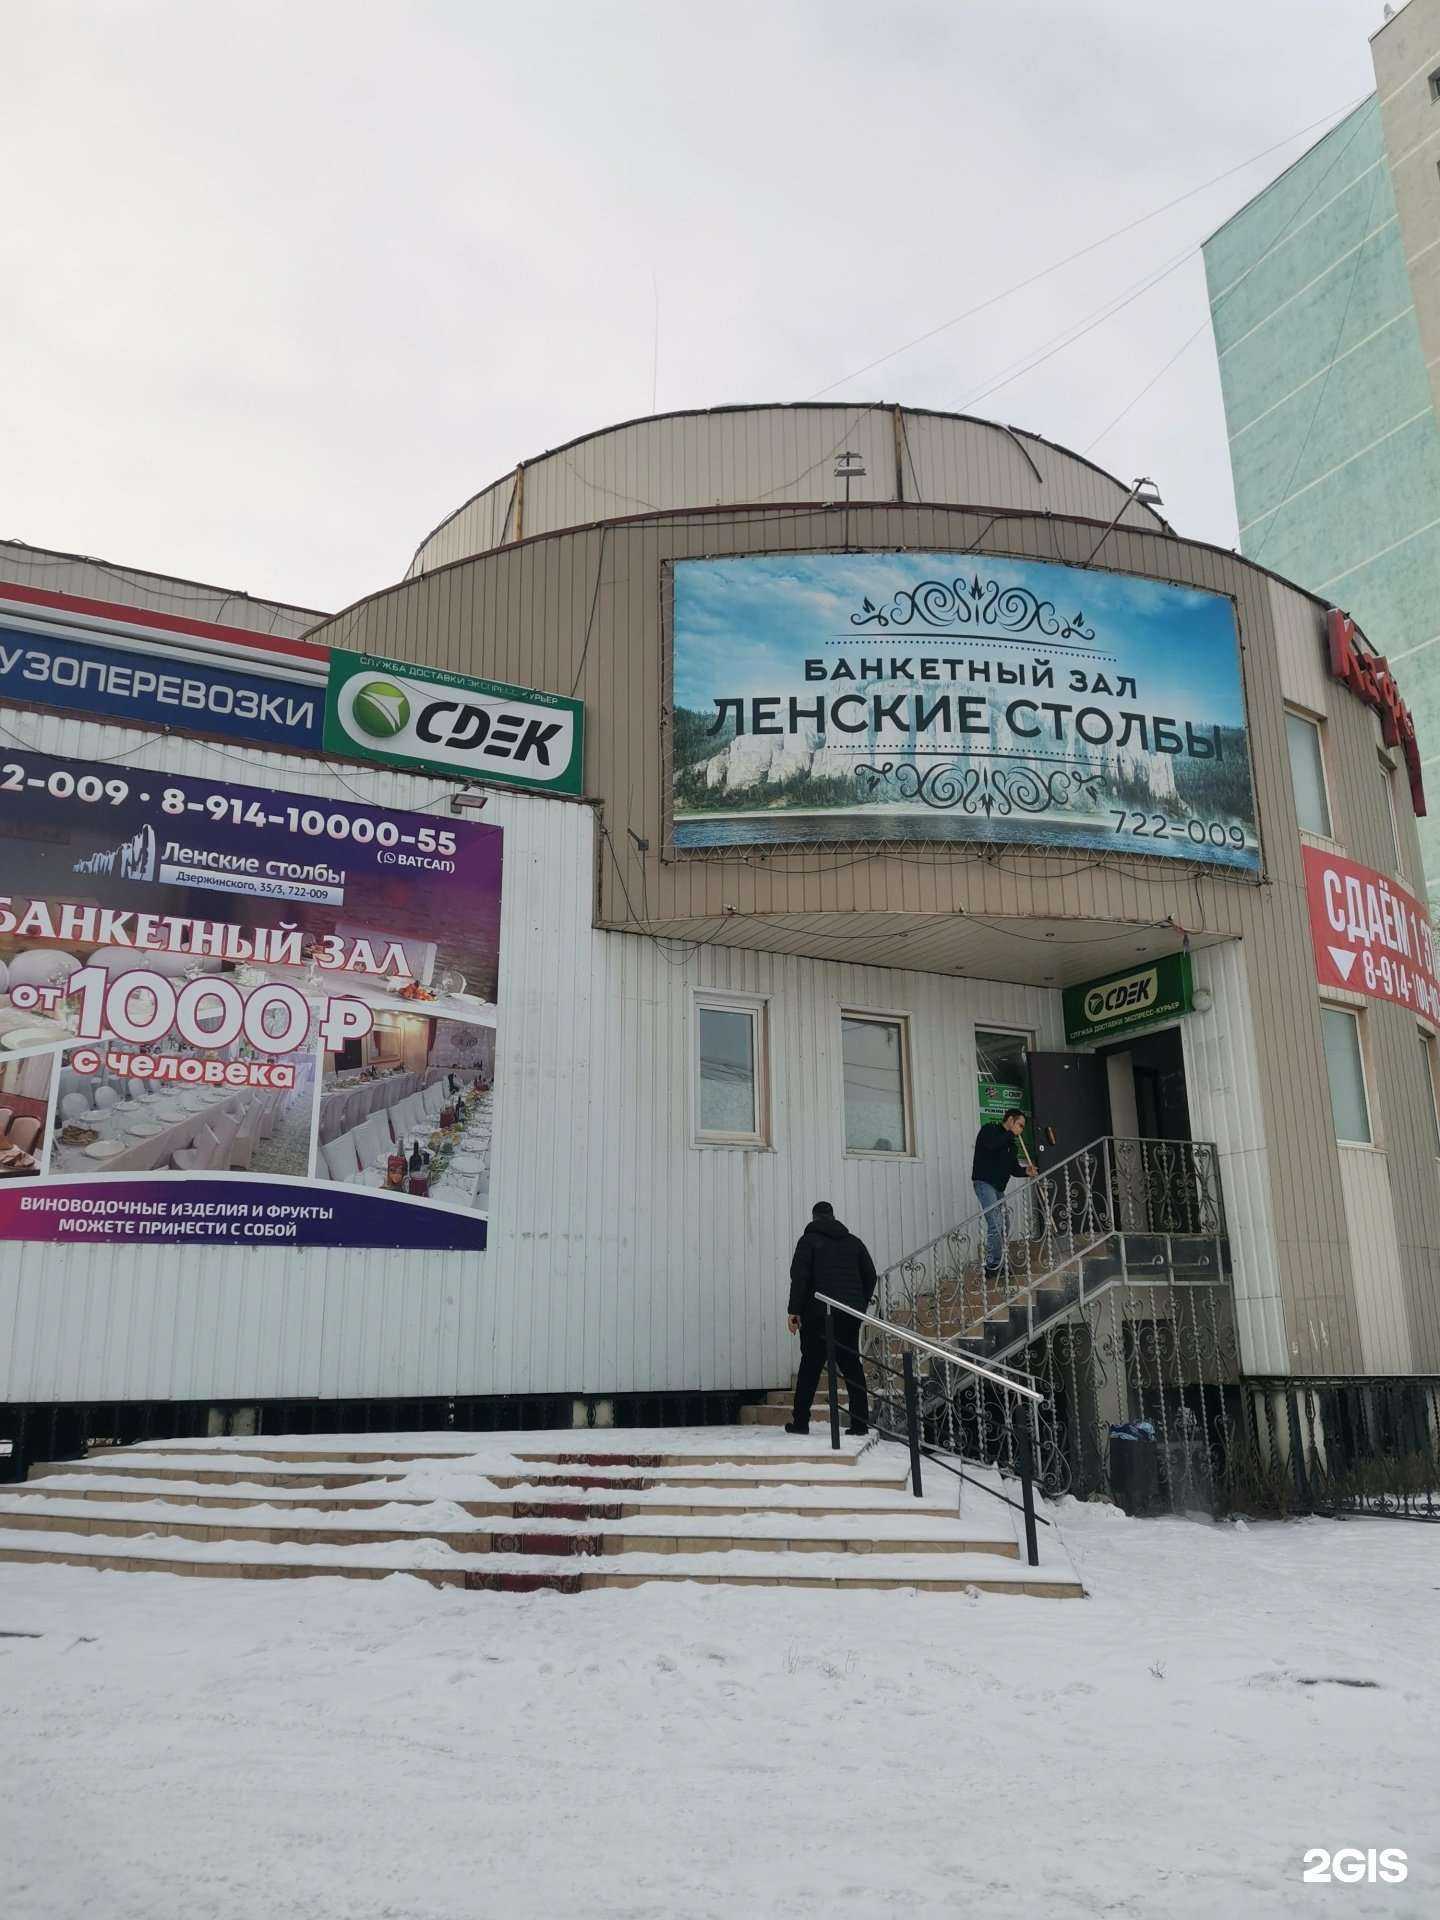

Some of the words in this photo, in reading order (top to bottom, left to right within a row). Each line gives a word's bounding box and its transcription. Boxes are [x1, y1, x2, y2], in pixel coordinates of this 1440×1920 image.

[360, 656, 407, 673] СЛУЖБА
[409, 667, 465, 685] ДОСТАВКИ
[805, 658, 1054, 688] БАНКЕТНЫЙ
[1069, 669, 1137, 699] ЗАЛ
[416, 701, 563, 766] CDEK
[706, 694, 990, 737] ЛЕНСКИЕ
[1005, 699, 1223, 761] СТОЛБЫ
[161, 788, 457, 855] 8-914-10000-55
[1109, 810, 1245, 850] 722-009
[160, 841, 259, 874] Ленские
[265, 860, 346, 885] столбы
[176, 871, 258, 892] Дзержинского,
[288, 885, 328, 900] 722-009
[1323, 869, 1412, 959] СДАЁМ
[316, 934, 413, 977] ЗАЛ
[10, 985, 64, 1009] от
[68, 966, 311, 1054] 1000
[1104, 977, 1152, 1012] CDEK
[73, 1050, 100, 1073] с
[106, 1051, 296, 1089] человека
[20, 1197, 167, 1216] ВИНОВОДОЧНЫЕ
[171, 1202, 249, 1217] ИЗДЕЛИЯ
[252, 1204, 263, 1217] И
[266, 1204, 333, 1220] ФРУКТЫ
[58, 1218, 135, 1234] МОЖЕТЕ
[139, 1220, 226, 1236] ПРИНЕСТИ
[230, 1222, 241, 1236] С
[243, 1220, 297, 1237] СОБОЙ
